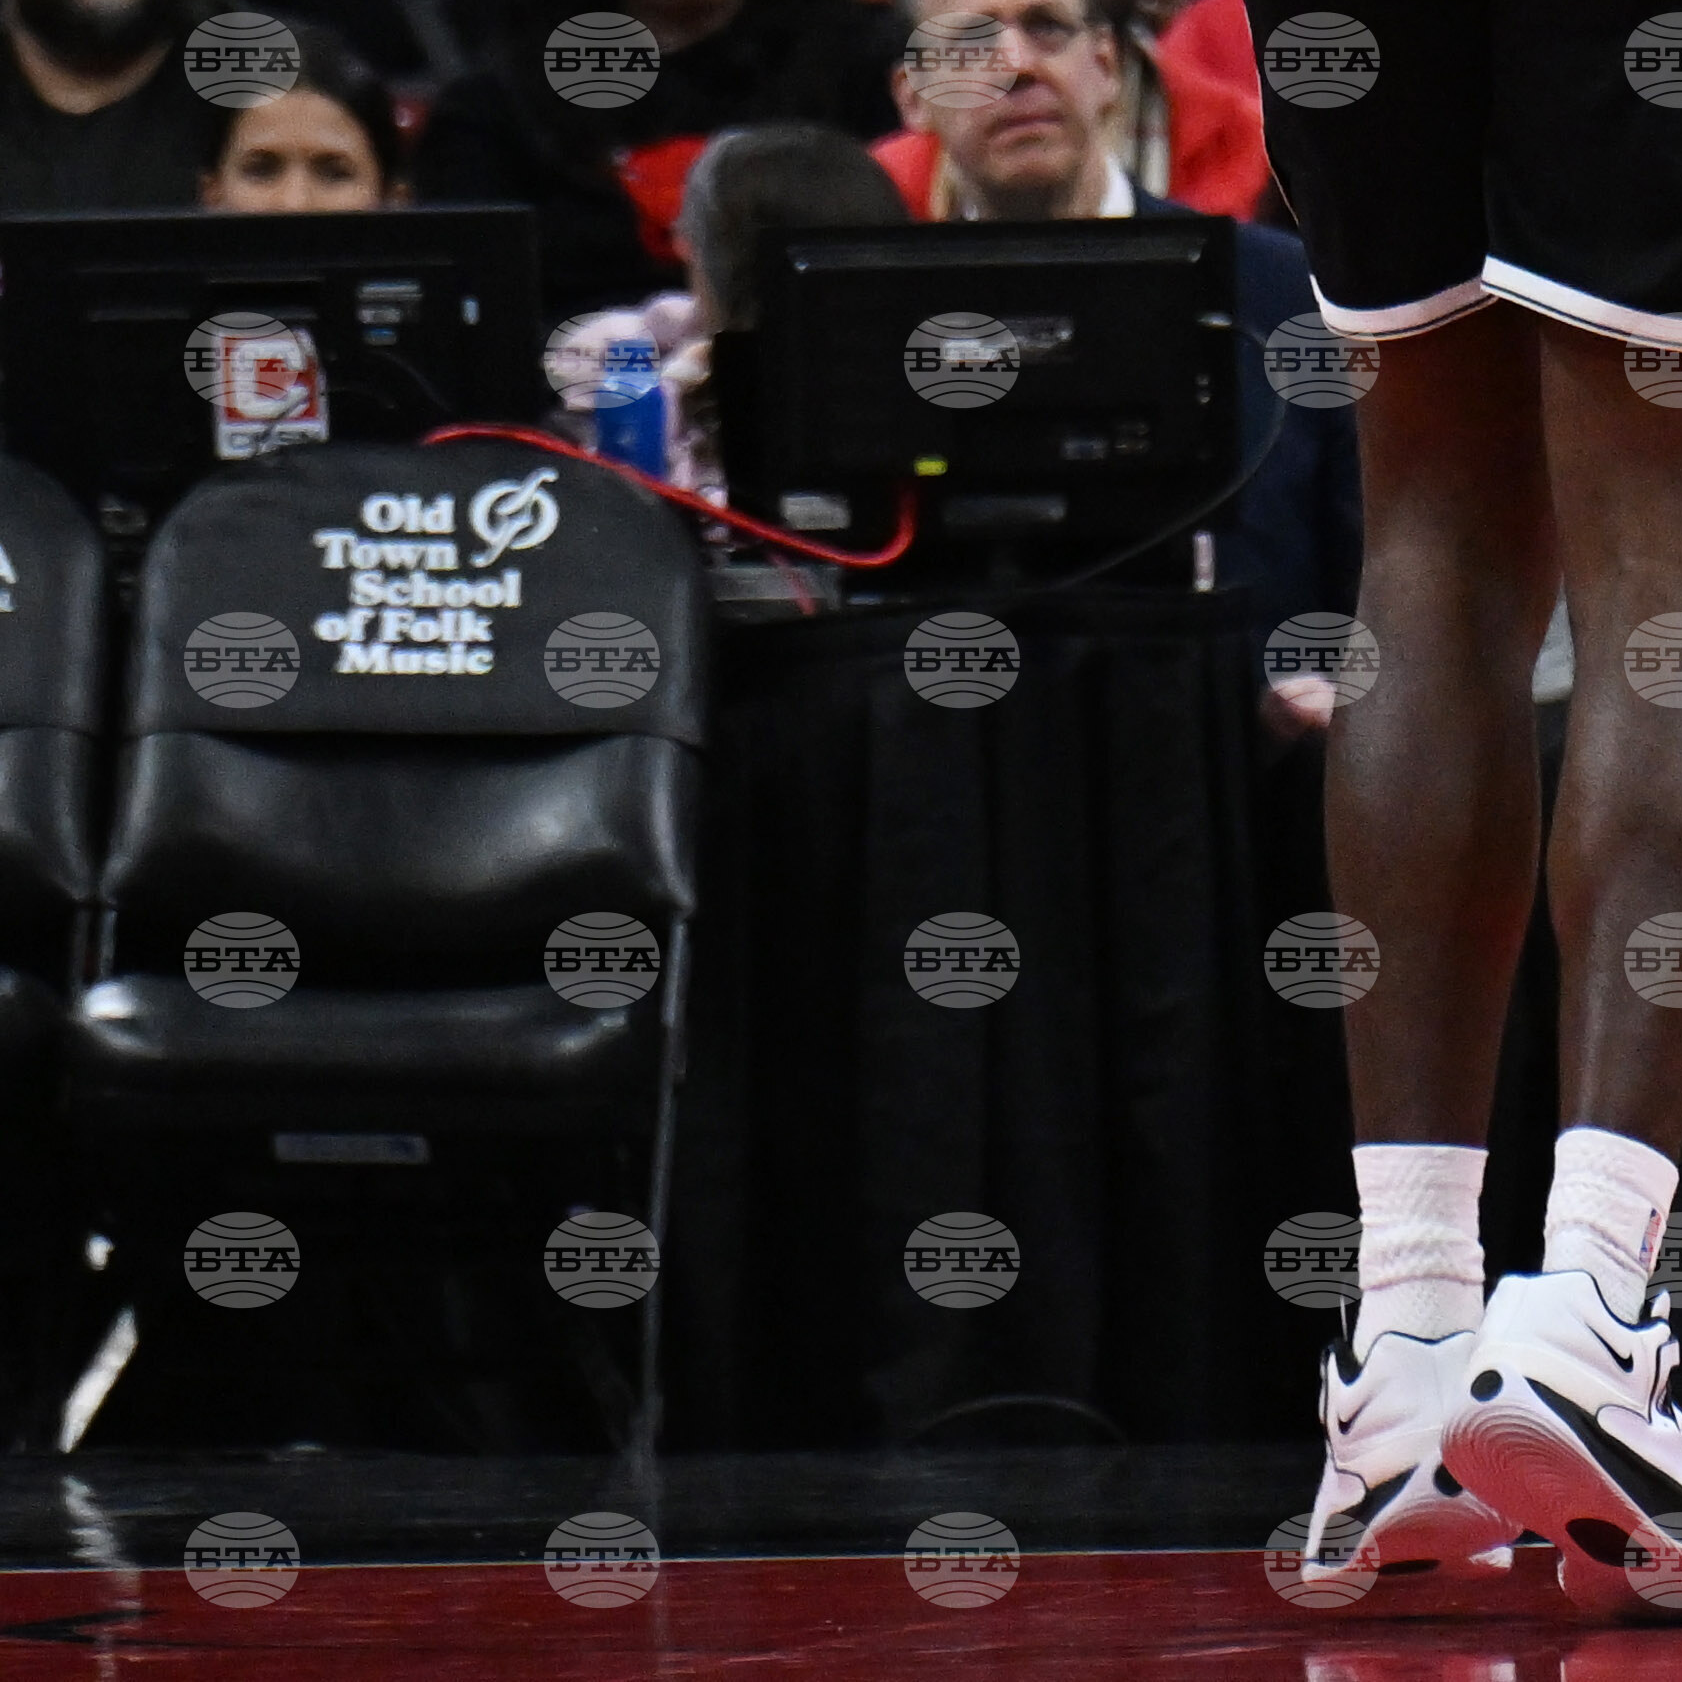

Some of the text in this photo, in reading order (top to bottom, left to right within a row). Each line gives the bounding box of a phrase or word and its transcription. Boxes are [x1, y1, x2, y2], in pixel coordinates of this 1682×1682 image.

[360, 492, 456, 534] Old
[312, 526, 459, 571] Town
[350, 568, 523, 609] School
[312, 608, 494, 643] of Folk
[335, 641, 496, 675] Music
